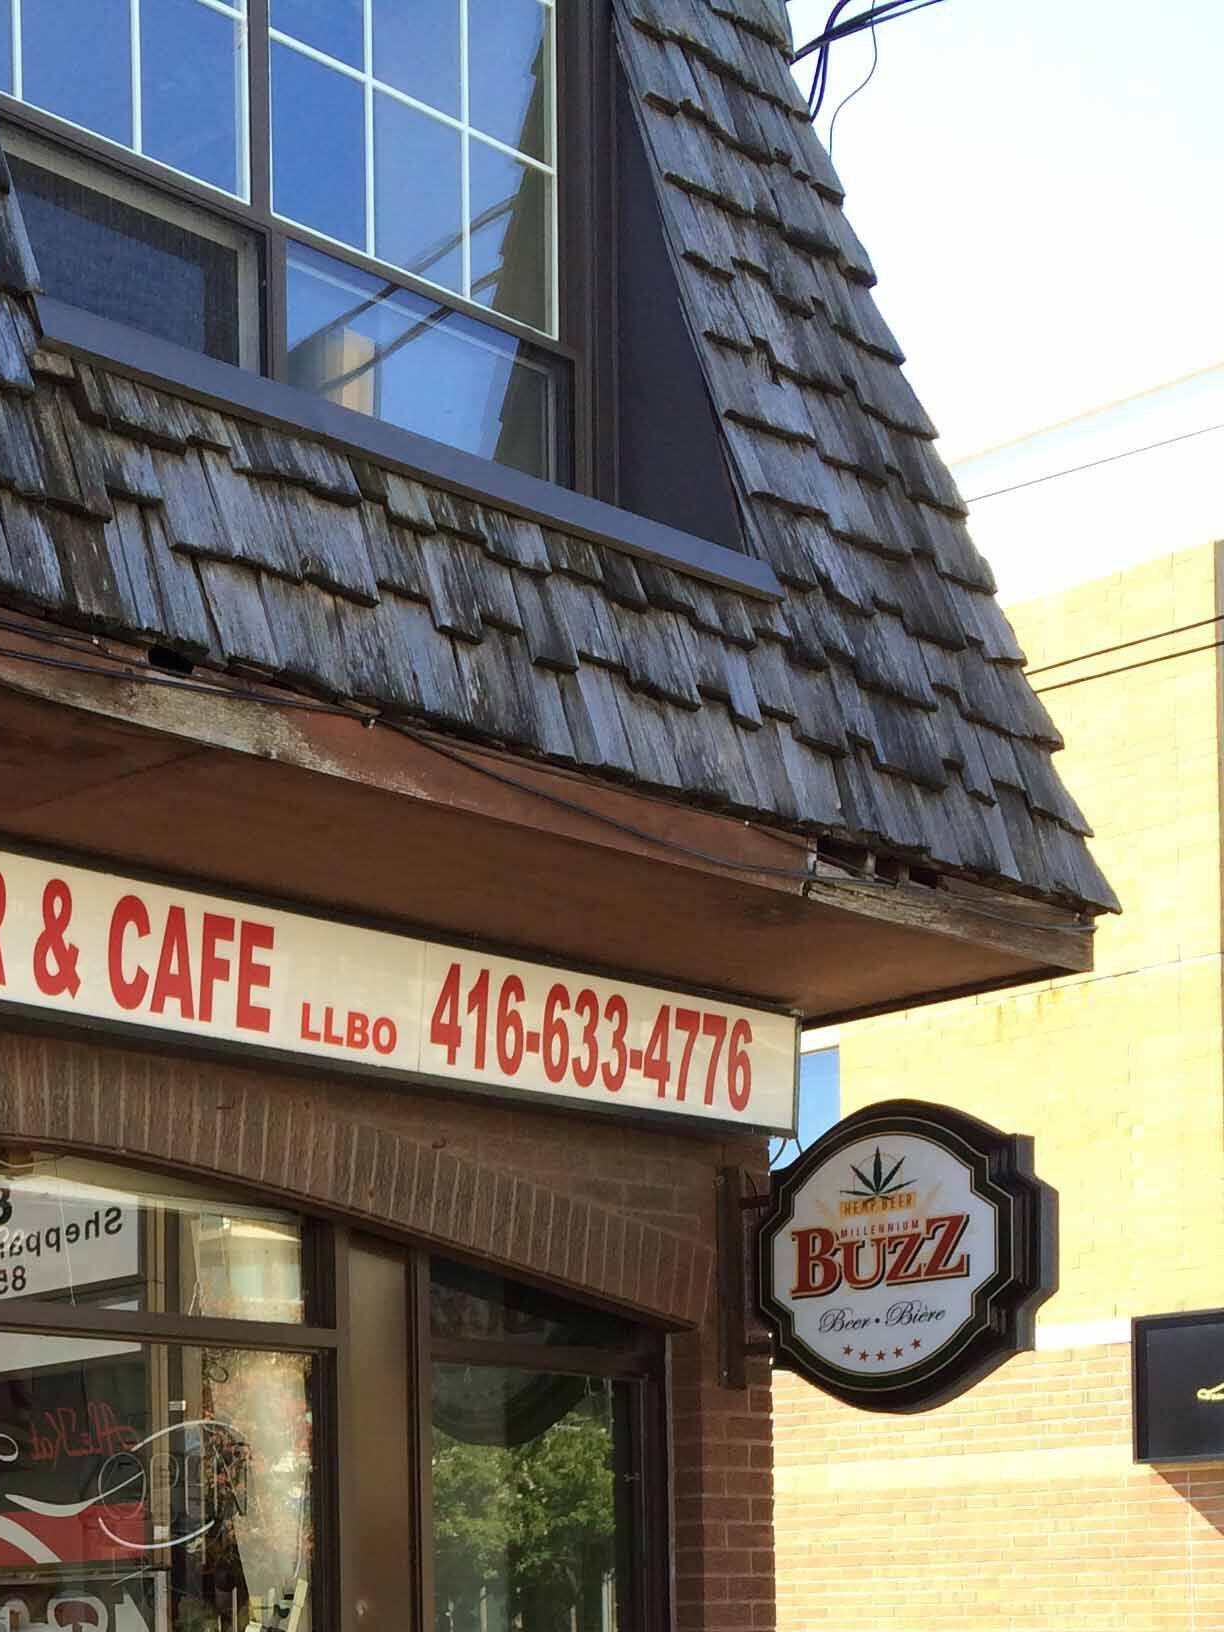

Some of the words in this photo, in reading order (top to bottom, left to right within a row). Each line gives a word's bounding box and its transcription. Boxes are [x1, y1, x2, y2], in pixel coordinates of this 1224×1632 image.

[32, 876, 82, 1000] &
[107, 893, 277, 1034] CAFE
[299, 1001, 398, 1056] LLBO
[430, 961, 754, 1113] 416-633-4776
[881, 1195, 914, 1210] BEER
[840, 1219, 921, 1238] MILLENNIUM
[789, 1213, 970, 1300] BUZZ
[818, 1305, 873, 1334] Beer
[884, 1301, 948, 1331] Bière
